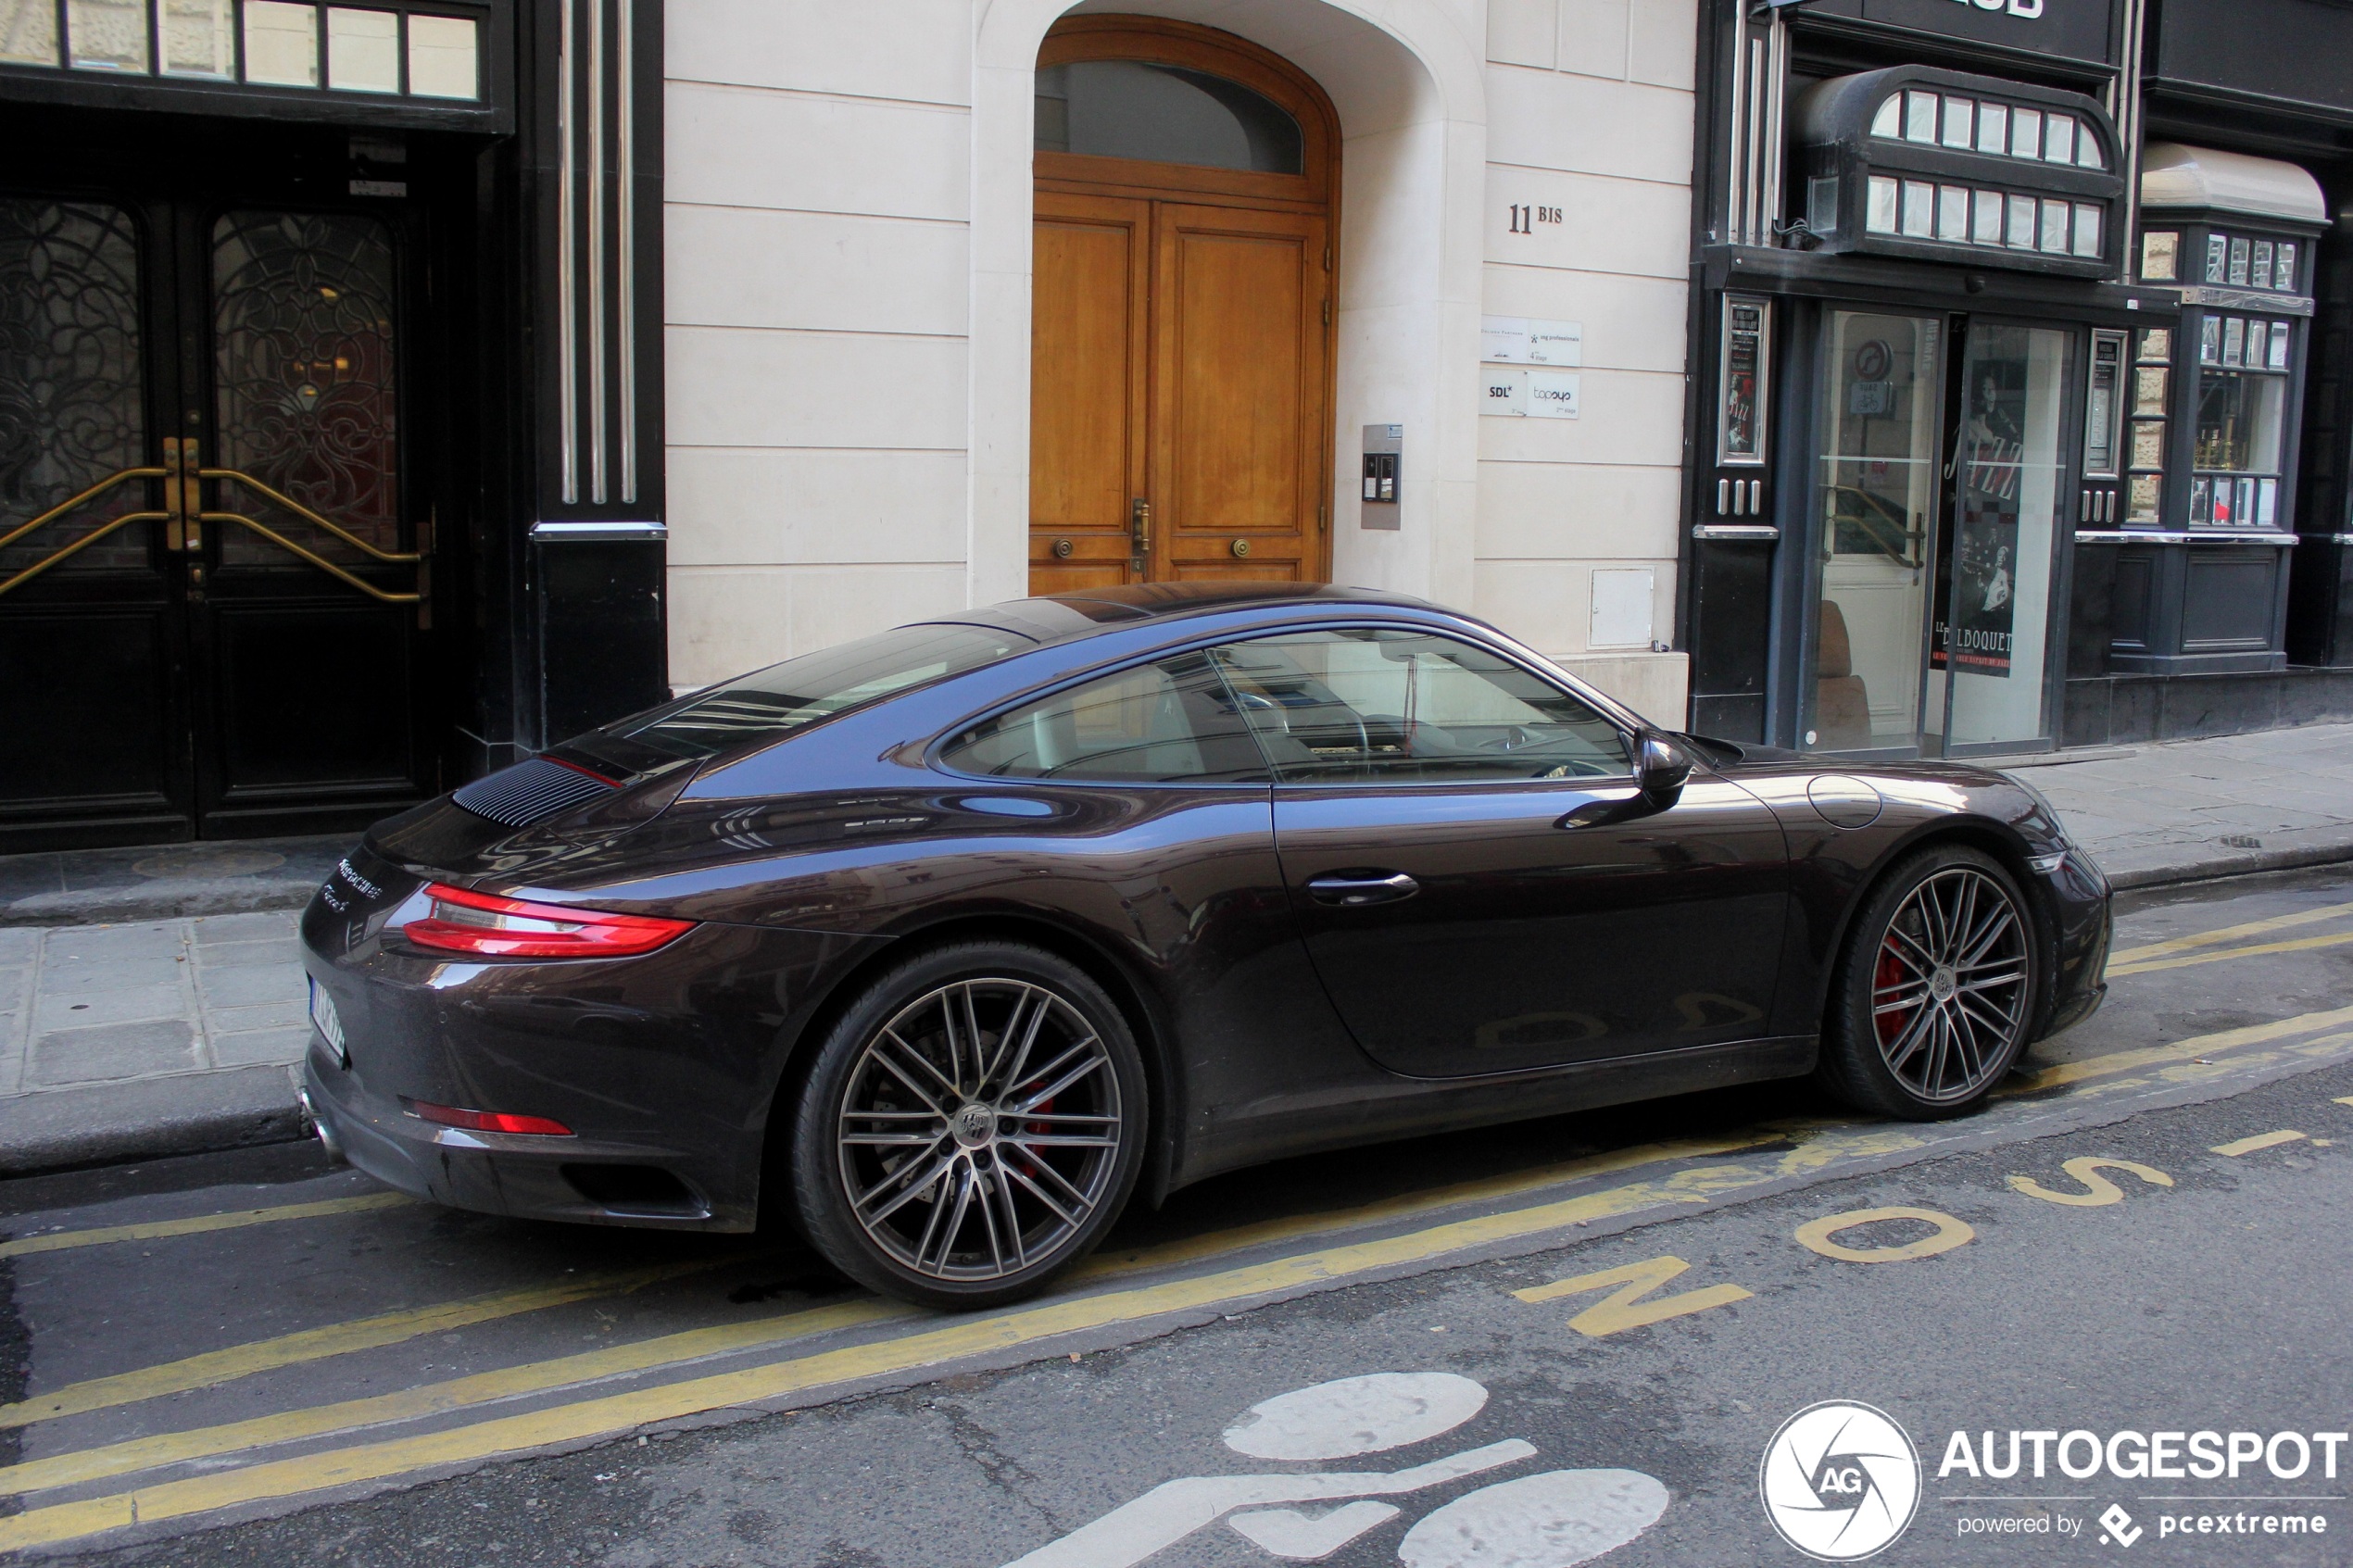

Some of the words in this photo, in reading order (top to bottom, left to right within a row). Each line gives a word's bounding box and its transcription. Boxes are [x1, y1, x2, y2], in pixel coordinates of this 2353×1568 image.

[1509, 204, 1531, 234] 11
[1538, 207, 1563, 223] BIS
[1534, 385, 1571, 402] topsys
[1935, 621, 1944, 632] LE
[1943, 627, 2012, 651] BLBOQUET
